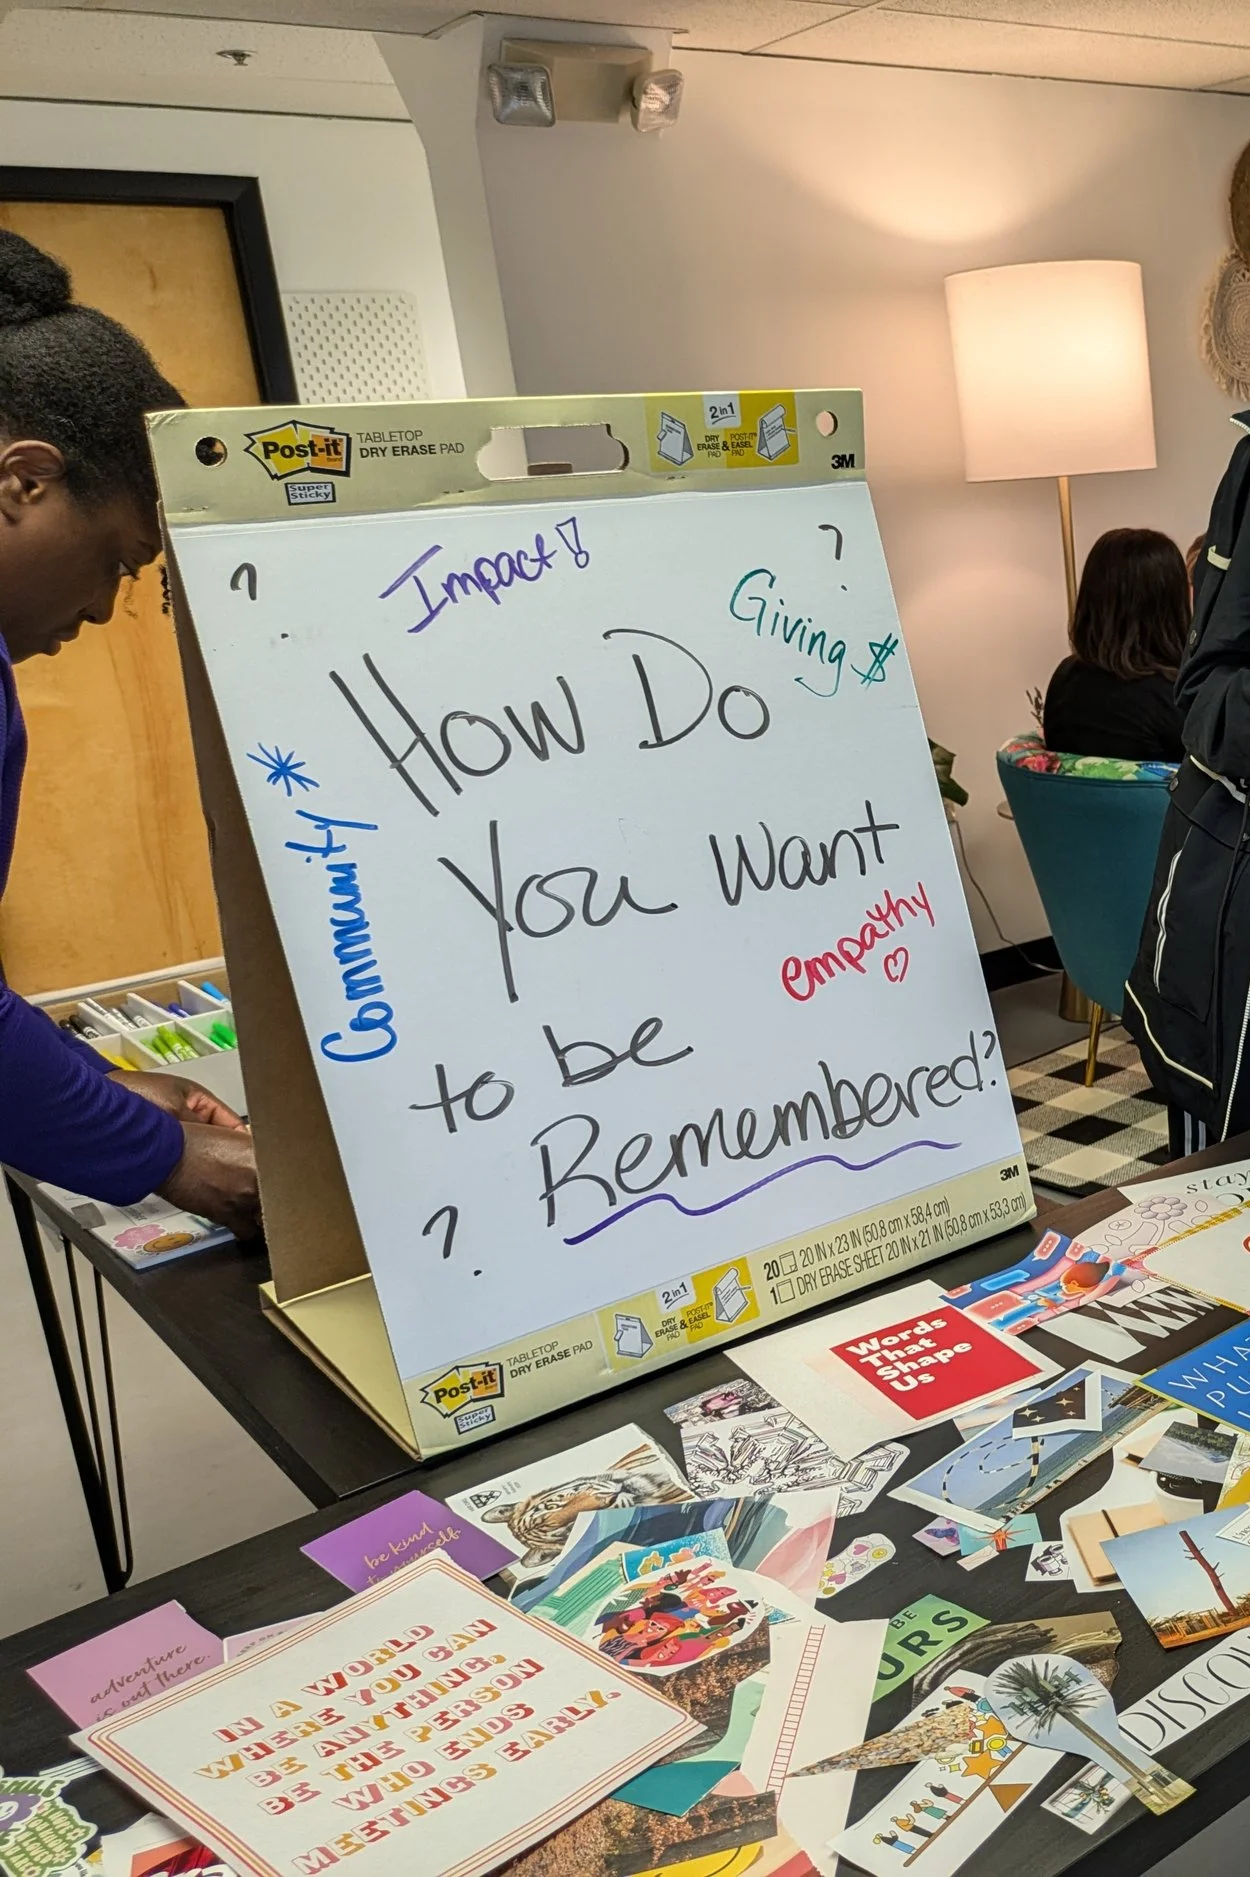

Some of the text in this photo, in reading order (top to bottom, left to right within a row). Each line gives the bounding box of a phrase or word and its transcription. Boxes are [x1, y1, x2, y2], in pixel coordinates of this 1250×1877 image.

[709, 404, 726, 419] 2 in
[263, 439, 343, 459] Post-it
[357, 430, 423, 444] TABLETOP
[697, 441, 729, 451] ERASE &
[705, 435, 719, 443] DRY
[360, 443, 465, 459] DRY ERASE PAD
[831, 454, 855, 469] 3M
[289, 485, 329, 493] Super
[291, 491, 331, 500] Sticky
[379, 516, 589, 634] Impact!
[728, 568, 899, 699] Giving $
[437, 800, 899, 1003] You Want
[286, 807, 400, 1065] Community
[781, 882, 934, 1001] empathy
[409, 1016, 694, 1134] to be
[530, 1029, 999, 1226] Remembered?
[1000, 1165, 1019, 1181] 3M
[1187, 1169, 1250, 1194] stay
[764, 1203, 932, 1281] 20 20 IN 23 IN 58,4
[798, 1192, 1027, 1295] DRY ERASE SHEET 20 IN 21 IN 53,3 cm)
[662, 1289, 680, 1304] 2 in
[655, 1324, 678, 1337] ERASE
[661, 1317, 676, 1328] DRY
[689, 1312, 711, 1325] EASEL
[690, 1322, 703, 1332] PAD
[667, 1332, 680, 1341] PAD
[846, 1317, 947, 1356] Words
[506, 1341, 559, 1367] TABLETOP
[510, 1340, 593, 1379] DRY ERASE PAD
[860, 1337, 938, 1368] That
[876, 1342, 973, 1382] Shape
[434, 1369, 496, 1404] Post-it
[889, 1372, 935, 1392] Us
[458, 1408, 489, 1423] Super
[459, 1413, 491, 1429] Sticky
[364, 1521, 435, 1570] be kind
[889, 1610, 917, 1629] BE
[89, 1644, 187, 1704] adventure
[212, 1716, 265, 1745] IN
[268, 1698, 304, 1719] A
[300, 1623, 436, 1697] WORLD
[121, 1684, 151, 1708] out
[193, 1618, 499, 1780] WHERE YOU CAN
[246, 1653, 508, 1789] BE ANYTHING,
[257, 1657, 545, 1817] BE THE PERSON
[331, 1702, 535, 1812] WHO ENDS
[291, 1688, 623, 1876] MEETINGS EARLY.
